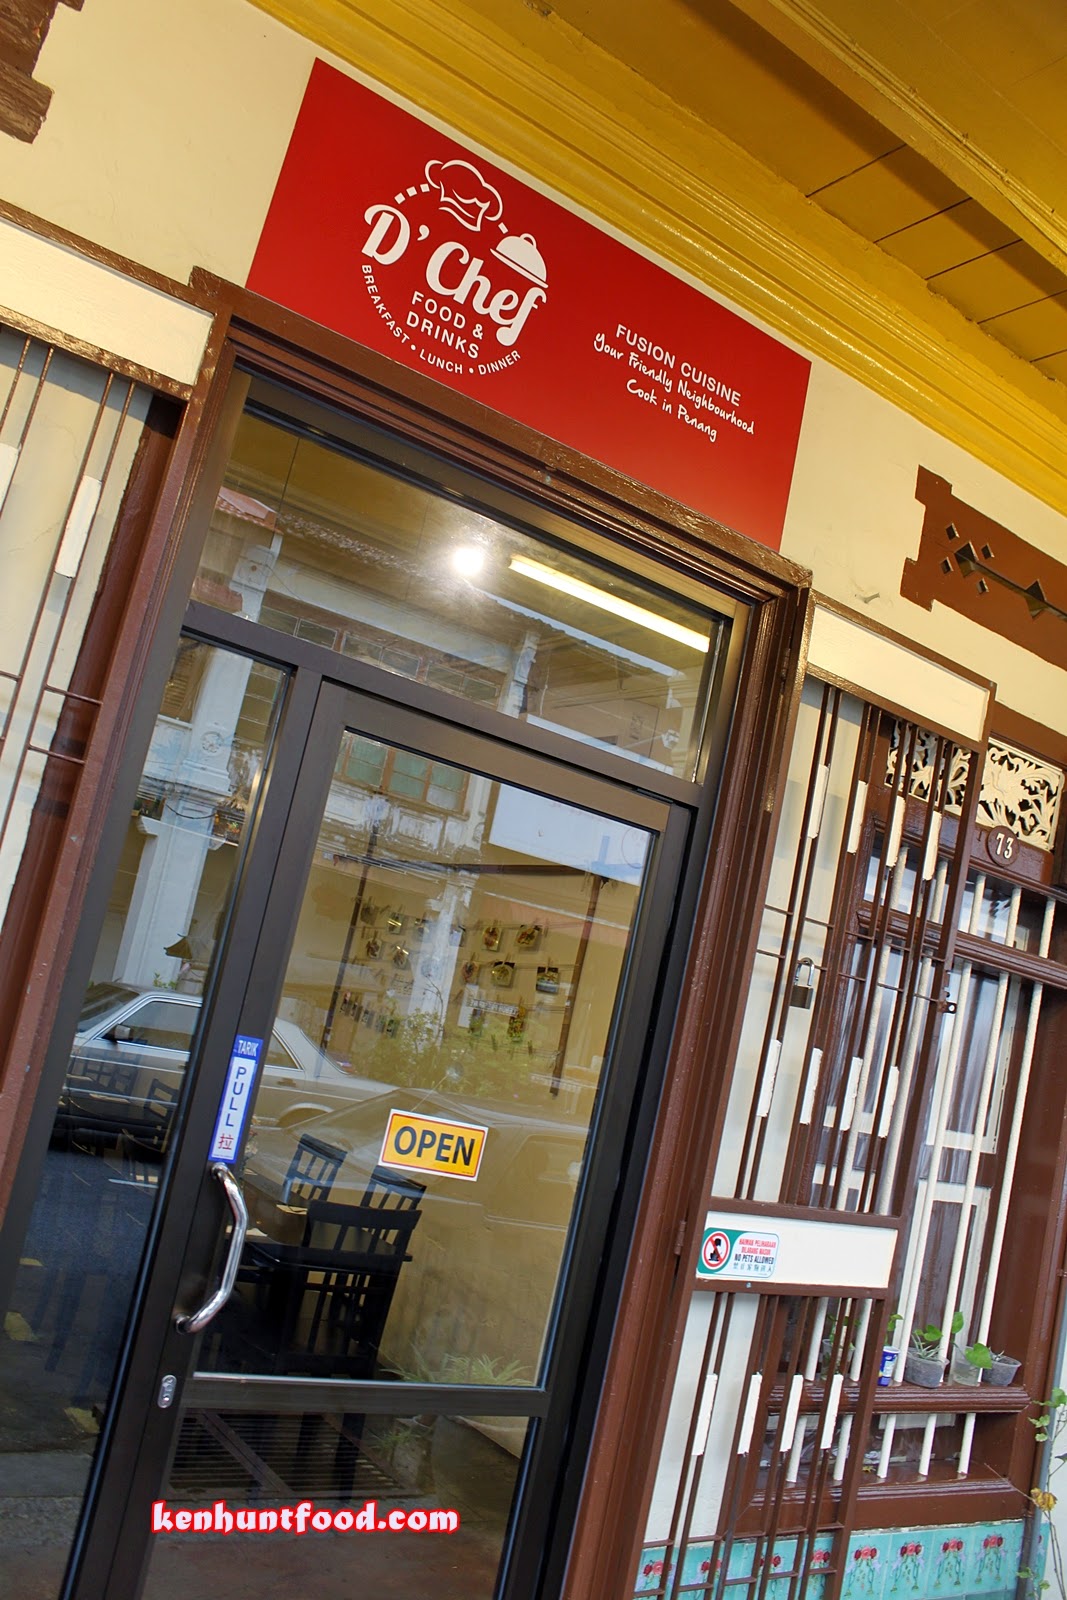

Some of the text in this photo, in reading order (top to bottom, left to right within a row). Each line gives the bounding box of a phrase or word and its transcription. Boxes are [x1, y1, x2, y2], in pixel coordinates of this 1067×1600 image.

[361, 264, 521, 375] BREAKFAST LUNCH DINNER
[406, 311, 480, 359] DRINKS
[411, 290, 484, 340] FOOD &
[593, 332, 755, 435] Your Friendly Neighbourhood
[615, 323, 742, 407] FUSION CUISINE
[626, 378, 717, 443] Cook in Penang
[996, 832, 1014, 859] 73
[238, 1040, 260, 1057] TARIK
[225, 1066, 247, 1127] PULL
[218, 1133, 235, 1150] 拉
[393, 1125, 476, 1167] OPEN
[754, 1256, 774, 1264] ALLOWED
